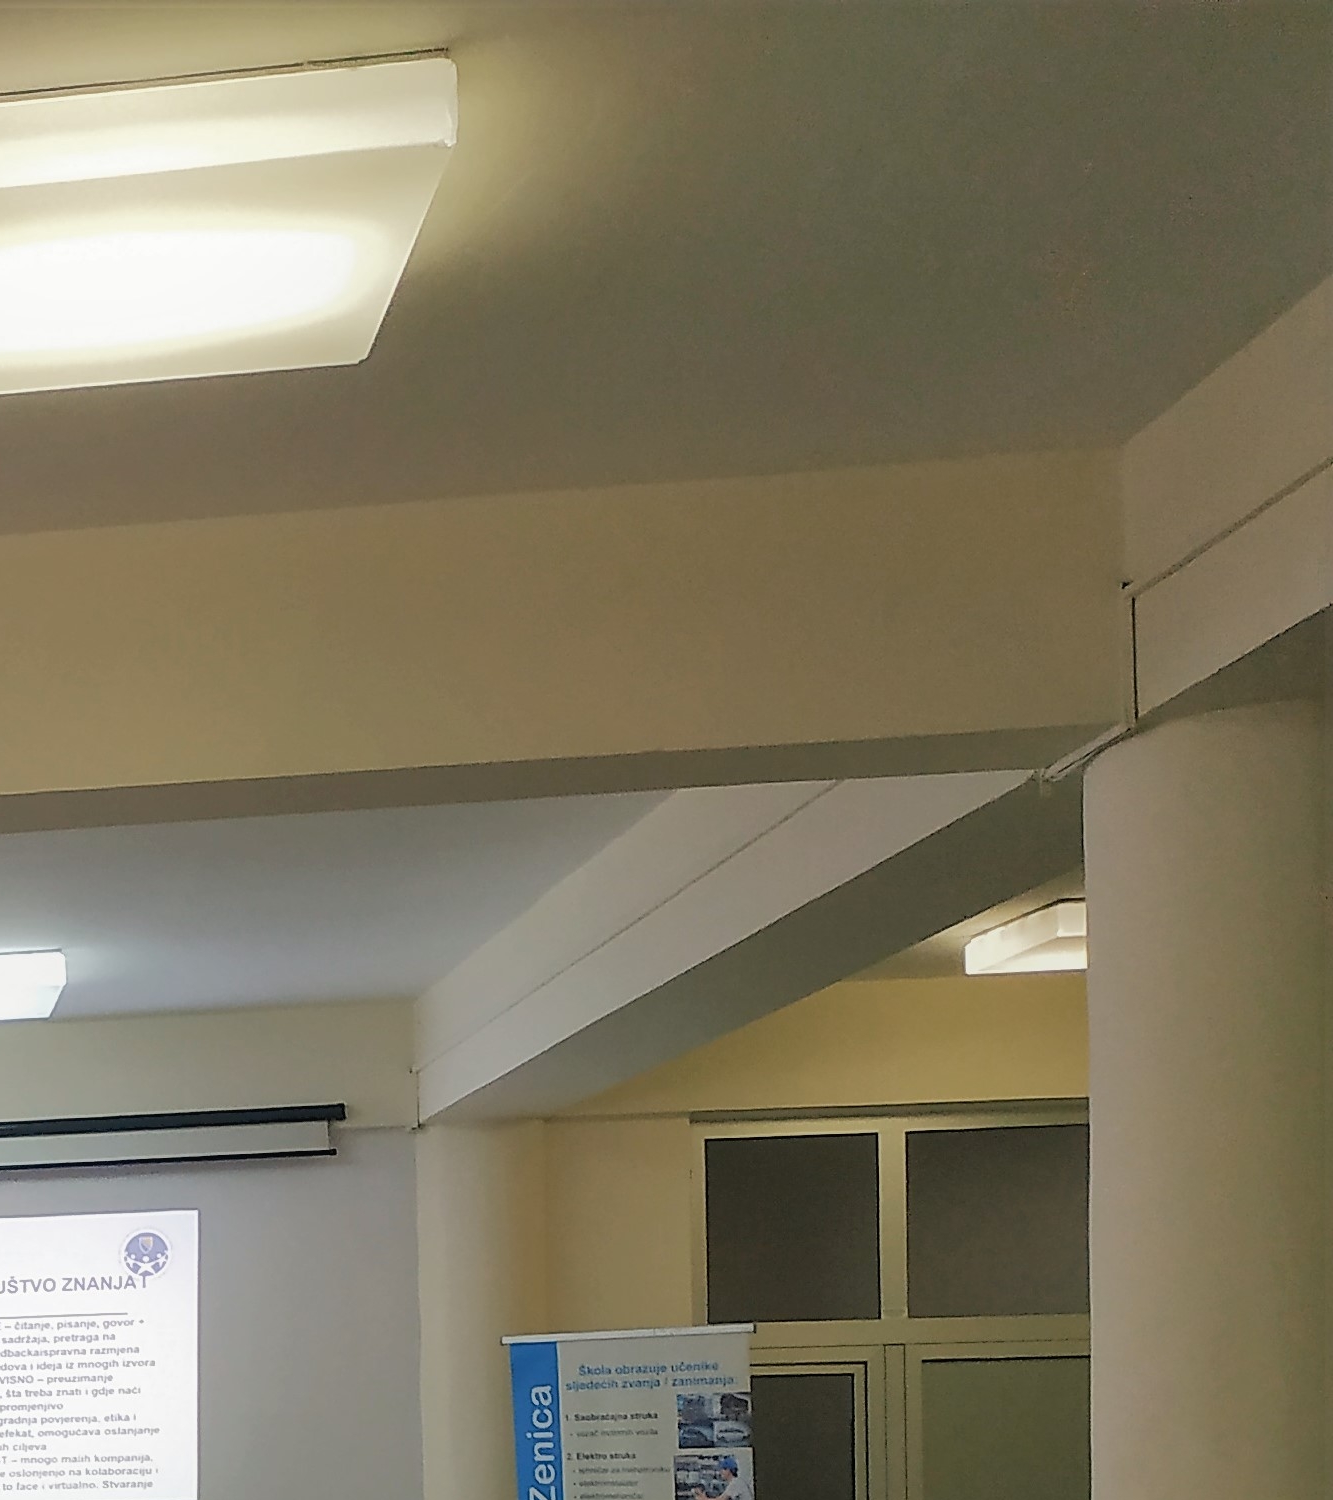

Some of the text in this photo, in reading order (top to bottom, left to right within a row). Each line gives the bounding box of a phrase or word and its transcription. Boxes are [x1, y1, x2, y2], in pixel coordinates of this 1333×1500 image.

[61, 1275, 137, 1292] ZNANJA
[57, 1320, 100, 1330] pisanje,
[103, 1319, 135, 1330] govor
[53, 1334, 99, 1344] pretraga
[89, 1346, 140, 1356] razmjena
[77, 1359, 119, 1371] mnogih
[123, 1359, 156, 1368] izvora
[579, 1364, 611, 1376] Škola
[615, 1364, 667, 1376] obrazuje
[621, 1380, 661, 1390] zvanja
[25, 1388, 53, 1398] treba
[91, 1386, 115, 1398] gdje
[0, 1402, 63, 1414] promjenjivo
[103, 1414, 130, 1422] etika
[630, 1412, 659, 1420] struka
[104, 1426, 161, 1436] oslanjanje
[13, 1442, 47, 1452] ciljeva
[576, 1452, 607, 1460] Elektro
[21, 1457, 58, 1466] mnogo
[3, 1482, 13, 1490] to
[102, 1480, 153, 1490] Stvaranje
